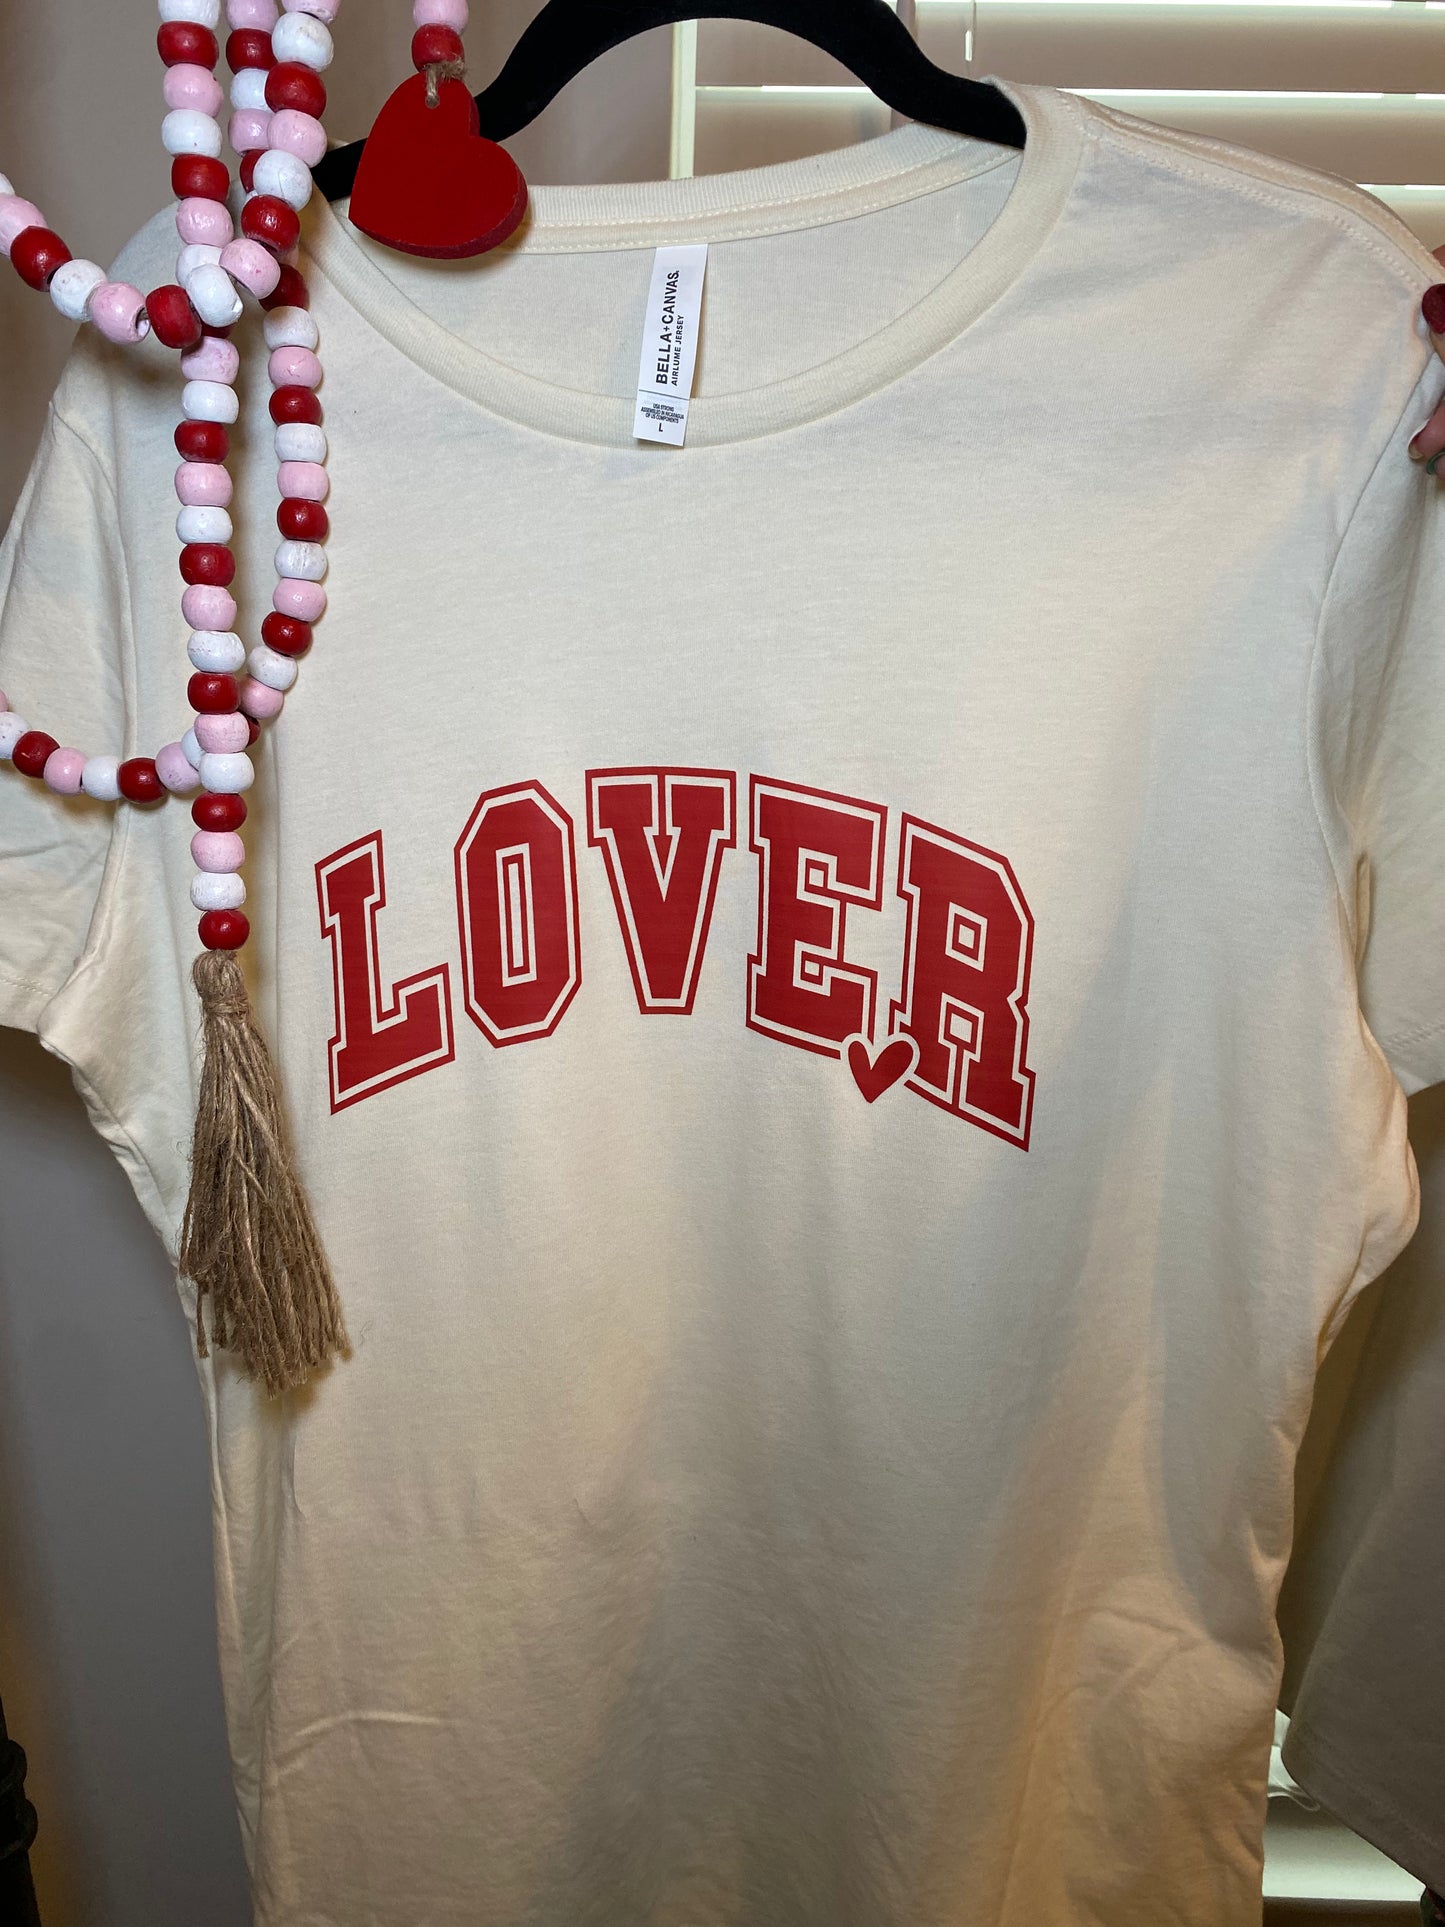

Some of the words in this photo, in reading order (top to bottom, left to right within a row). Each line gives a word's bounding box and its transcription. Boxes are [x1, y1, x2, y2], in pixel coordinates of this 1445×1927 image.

[674, 314, 685, 346] JERSEY
[671, 344, 682, 387] AIRLUME
[658, 423, 664, 432] L
[314, 766, 1037, 1152] LOVER
